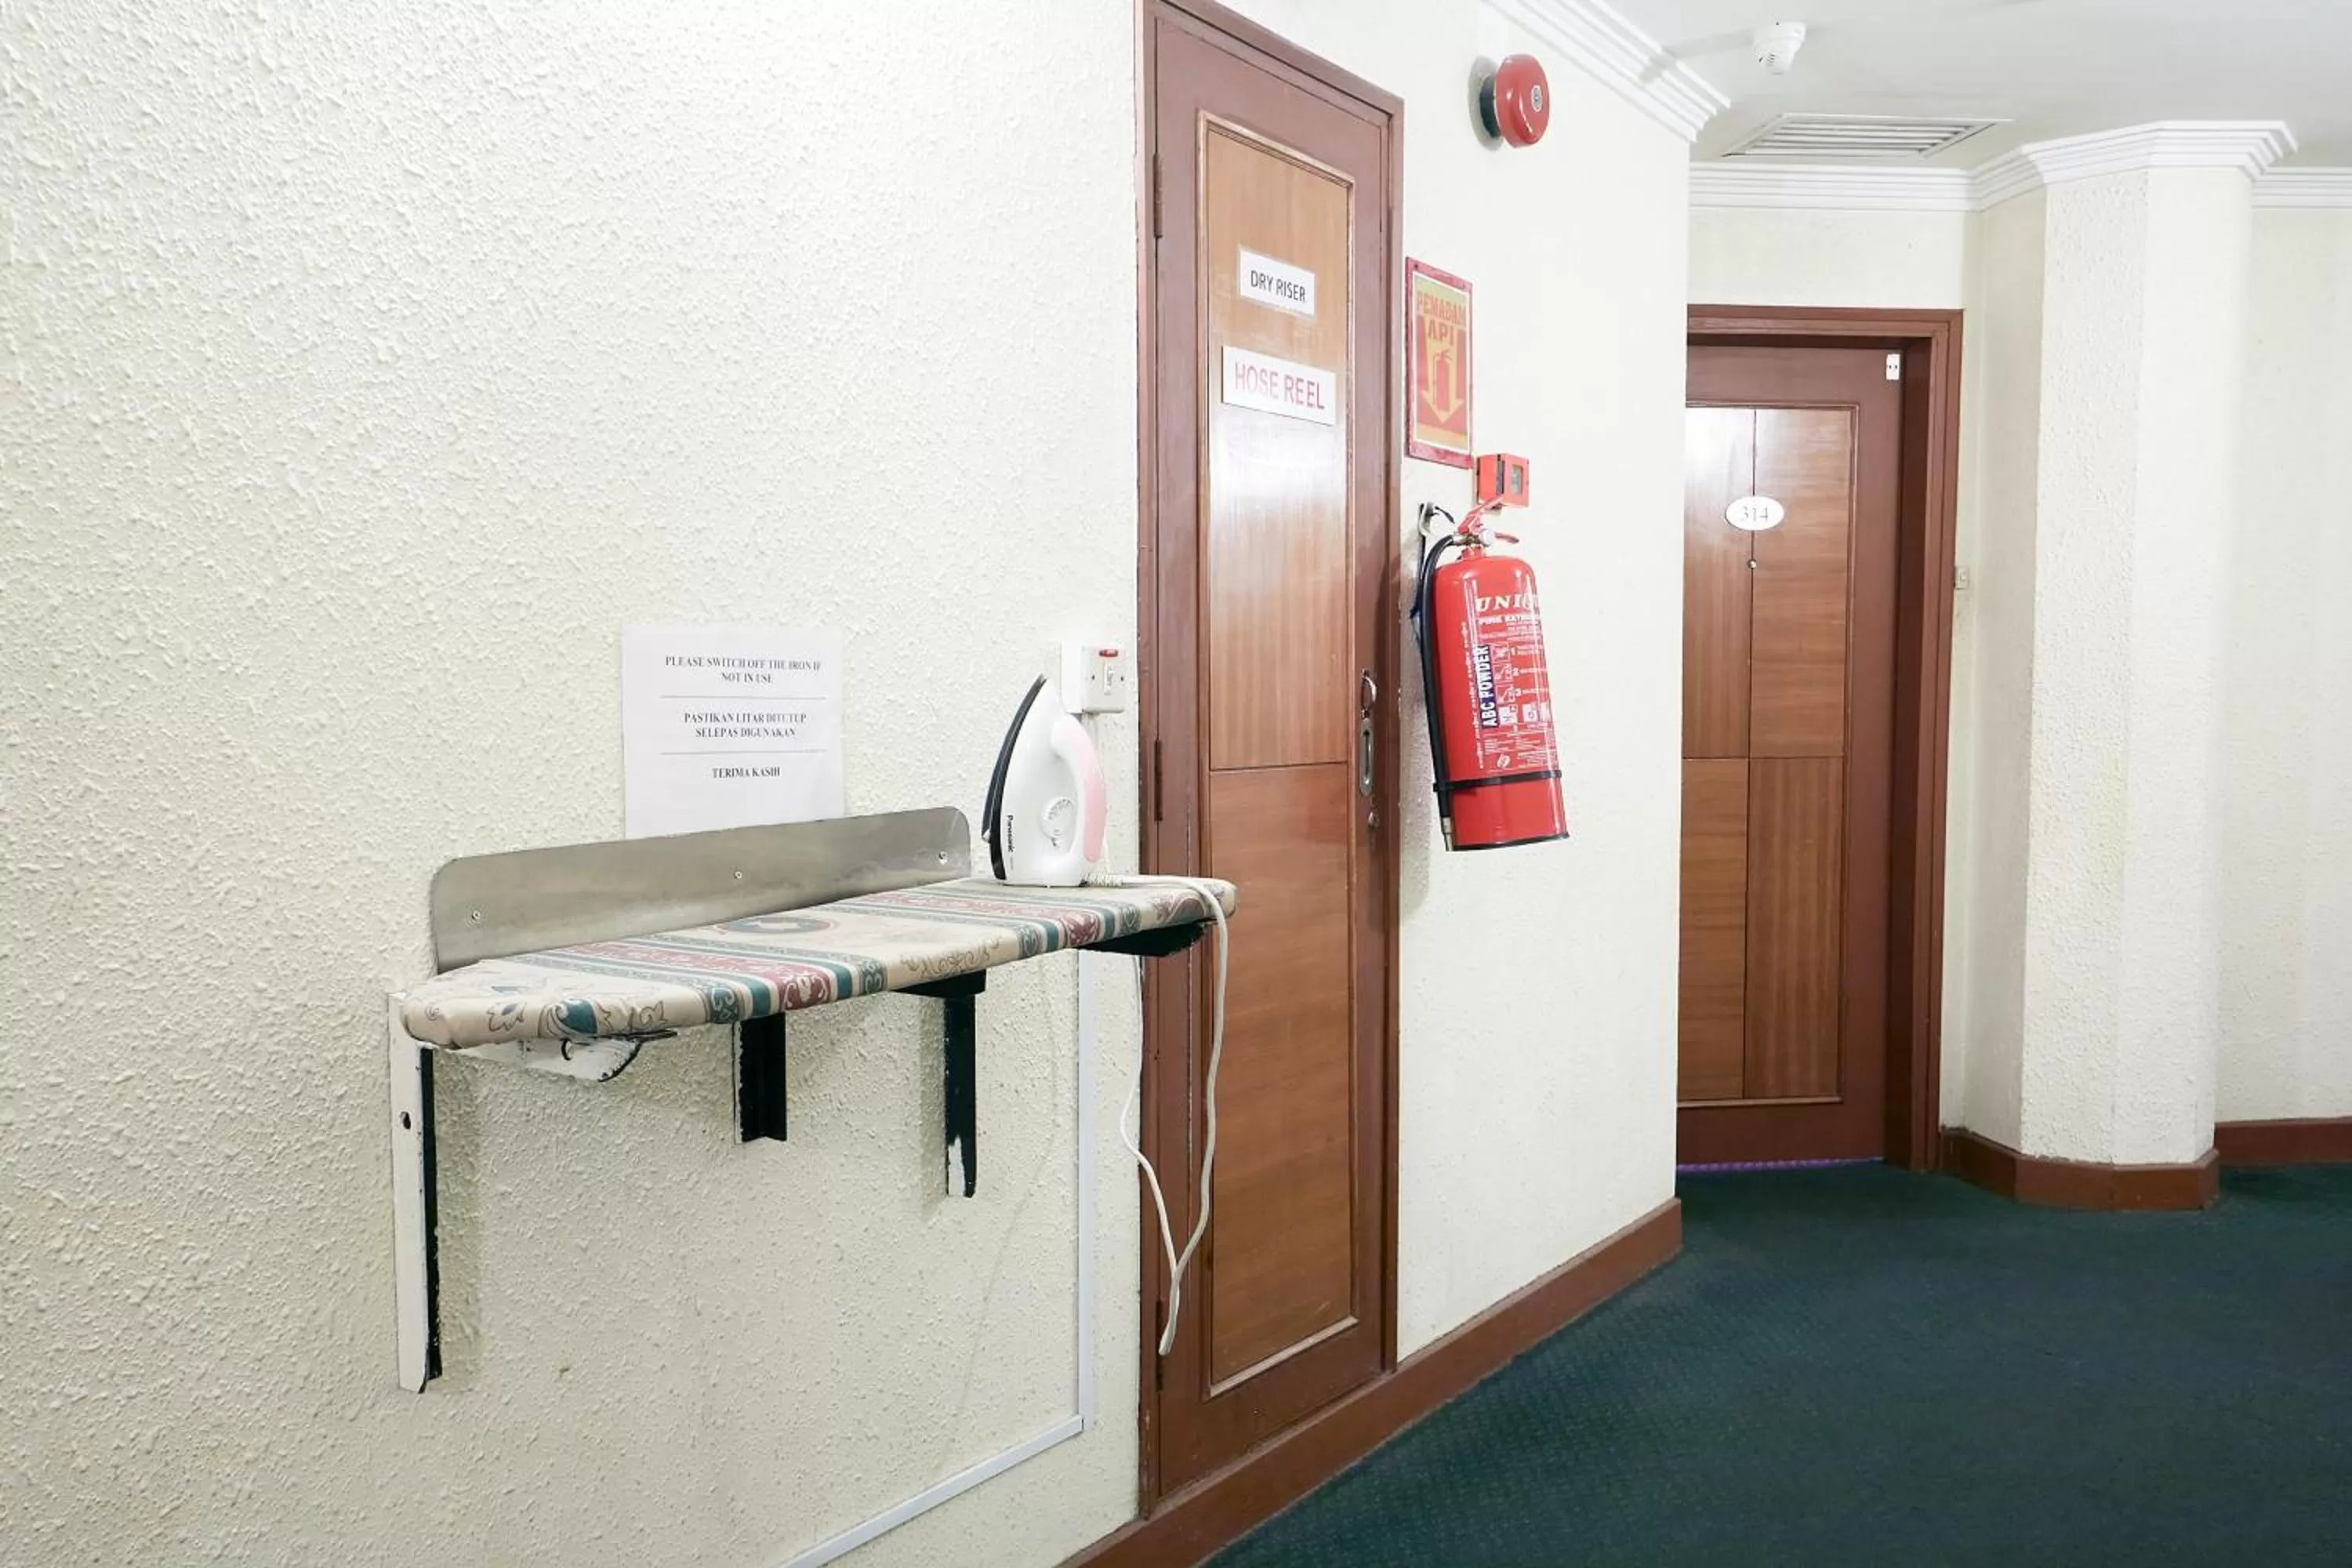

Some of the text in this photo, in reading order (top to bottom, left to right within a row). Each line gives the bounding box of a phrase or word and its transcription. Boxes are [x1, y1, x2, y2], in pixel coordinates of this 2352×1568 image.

[1250, 270, 1305, 302] DRY RISER
[1428, 318, 1454, 347] API
[1235, 362, 1326, 409] HOSE REEL
[1743, 503, 1769, 522] 314
[666, 656, 704, 666] PLEASE
[706, 657, 746, 667] SWITCH
[746, 658, 765, 669] OFF
[768, 659, 786, 670] THE
[788, 660, 811, 670] IRON
[1473, 644, 1494, 699] POWDER
[721, 672, 773, 683] NOT IN USE
[684, 712, 807, 724] PASTIKAN LITAR DITUTUP
[1480, 701, 1498, 728] ABC
[695, 727, 796, 738] SELEPAS DIGUNAKAN
[712, 766, 781, 779] TERIMA KASIH
[1007, 815, 1015, 853] Panasonic
